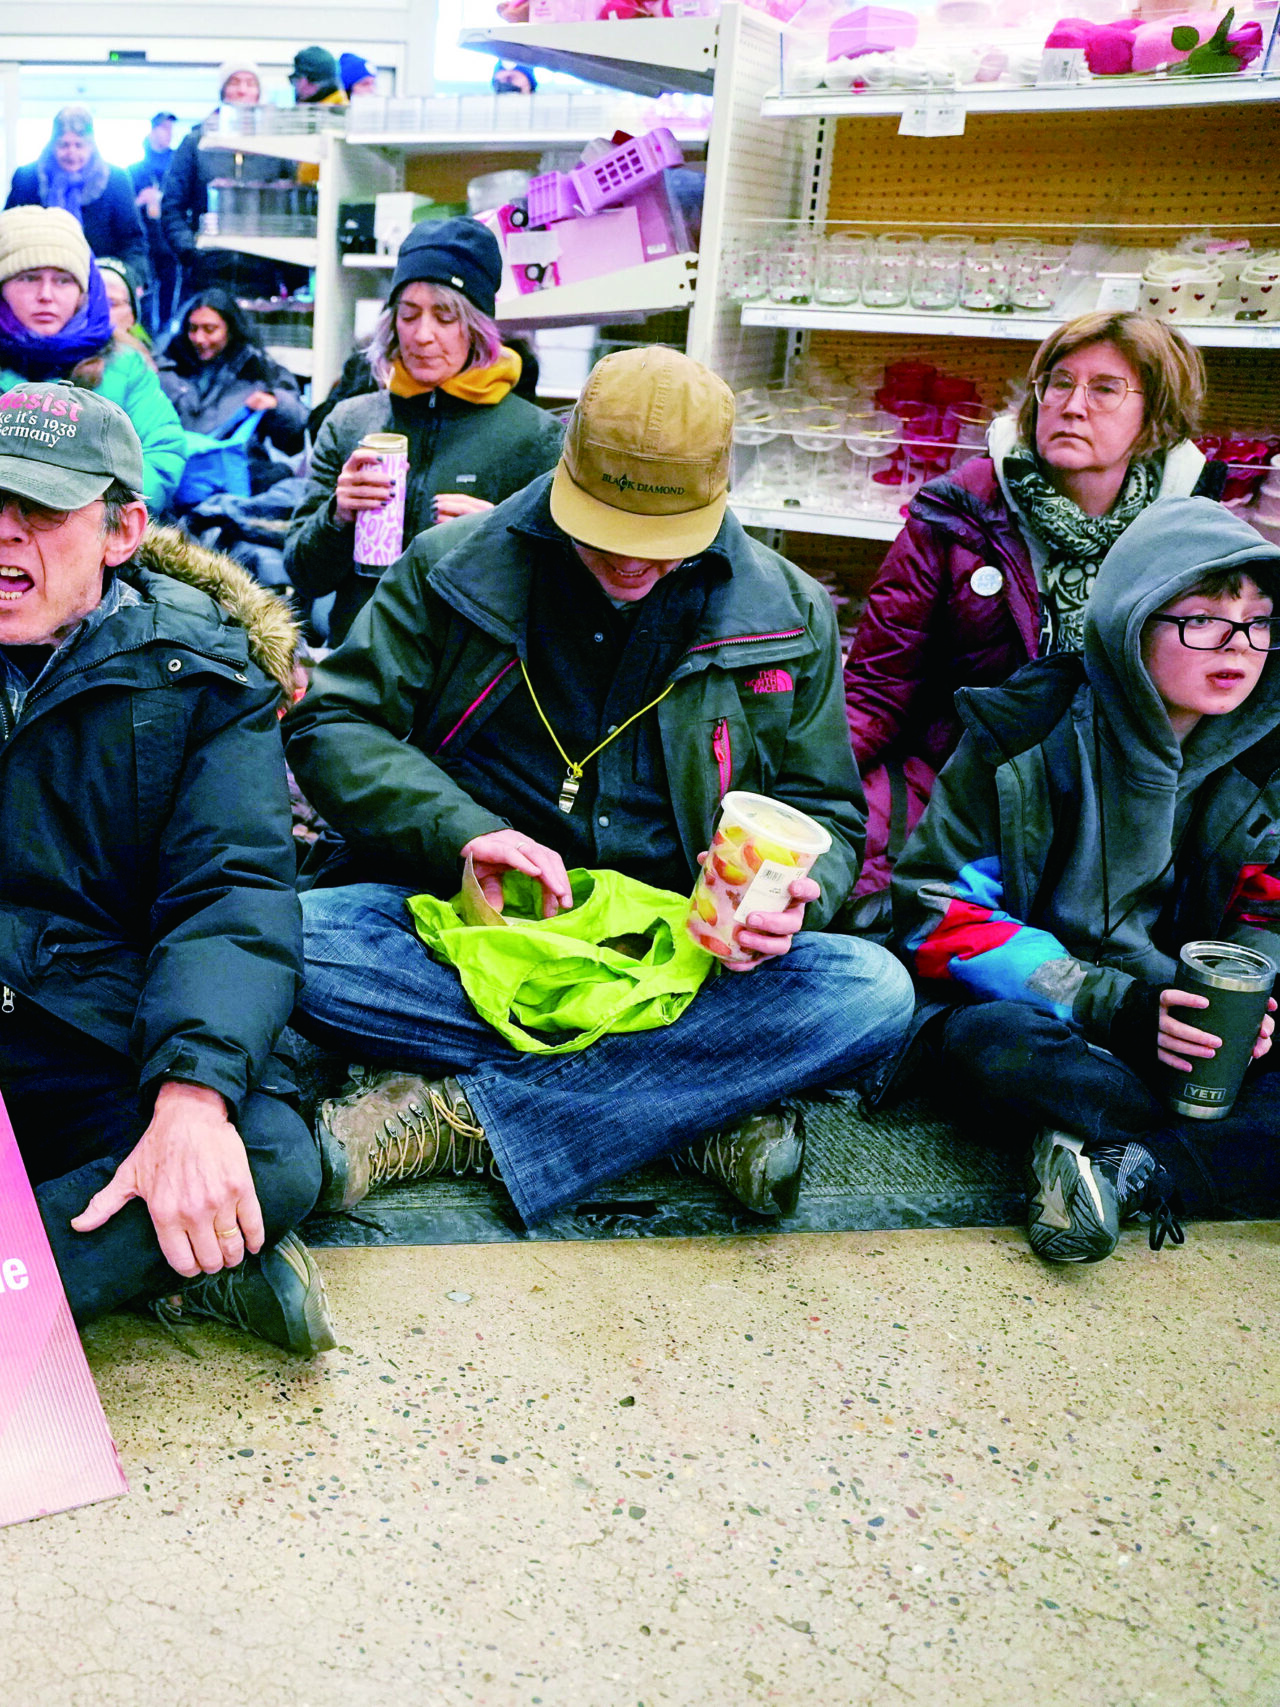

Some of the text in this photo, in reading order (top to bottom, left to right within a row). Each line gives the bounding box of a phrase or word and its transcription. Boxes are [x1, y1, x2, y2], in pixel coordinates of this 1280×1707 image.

[15, 410, 38, 425] it's
[43, 418, 77, 438] 1938
[602, 473, 685, 495] BLACK DIAMOND
[758, 670, 777, 680] THE
[745, 679, 777, 688] NORTH
[753, 686, 777, 694] FACE
[1190, 1086, 1223, 1100] YETI
